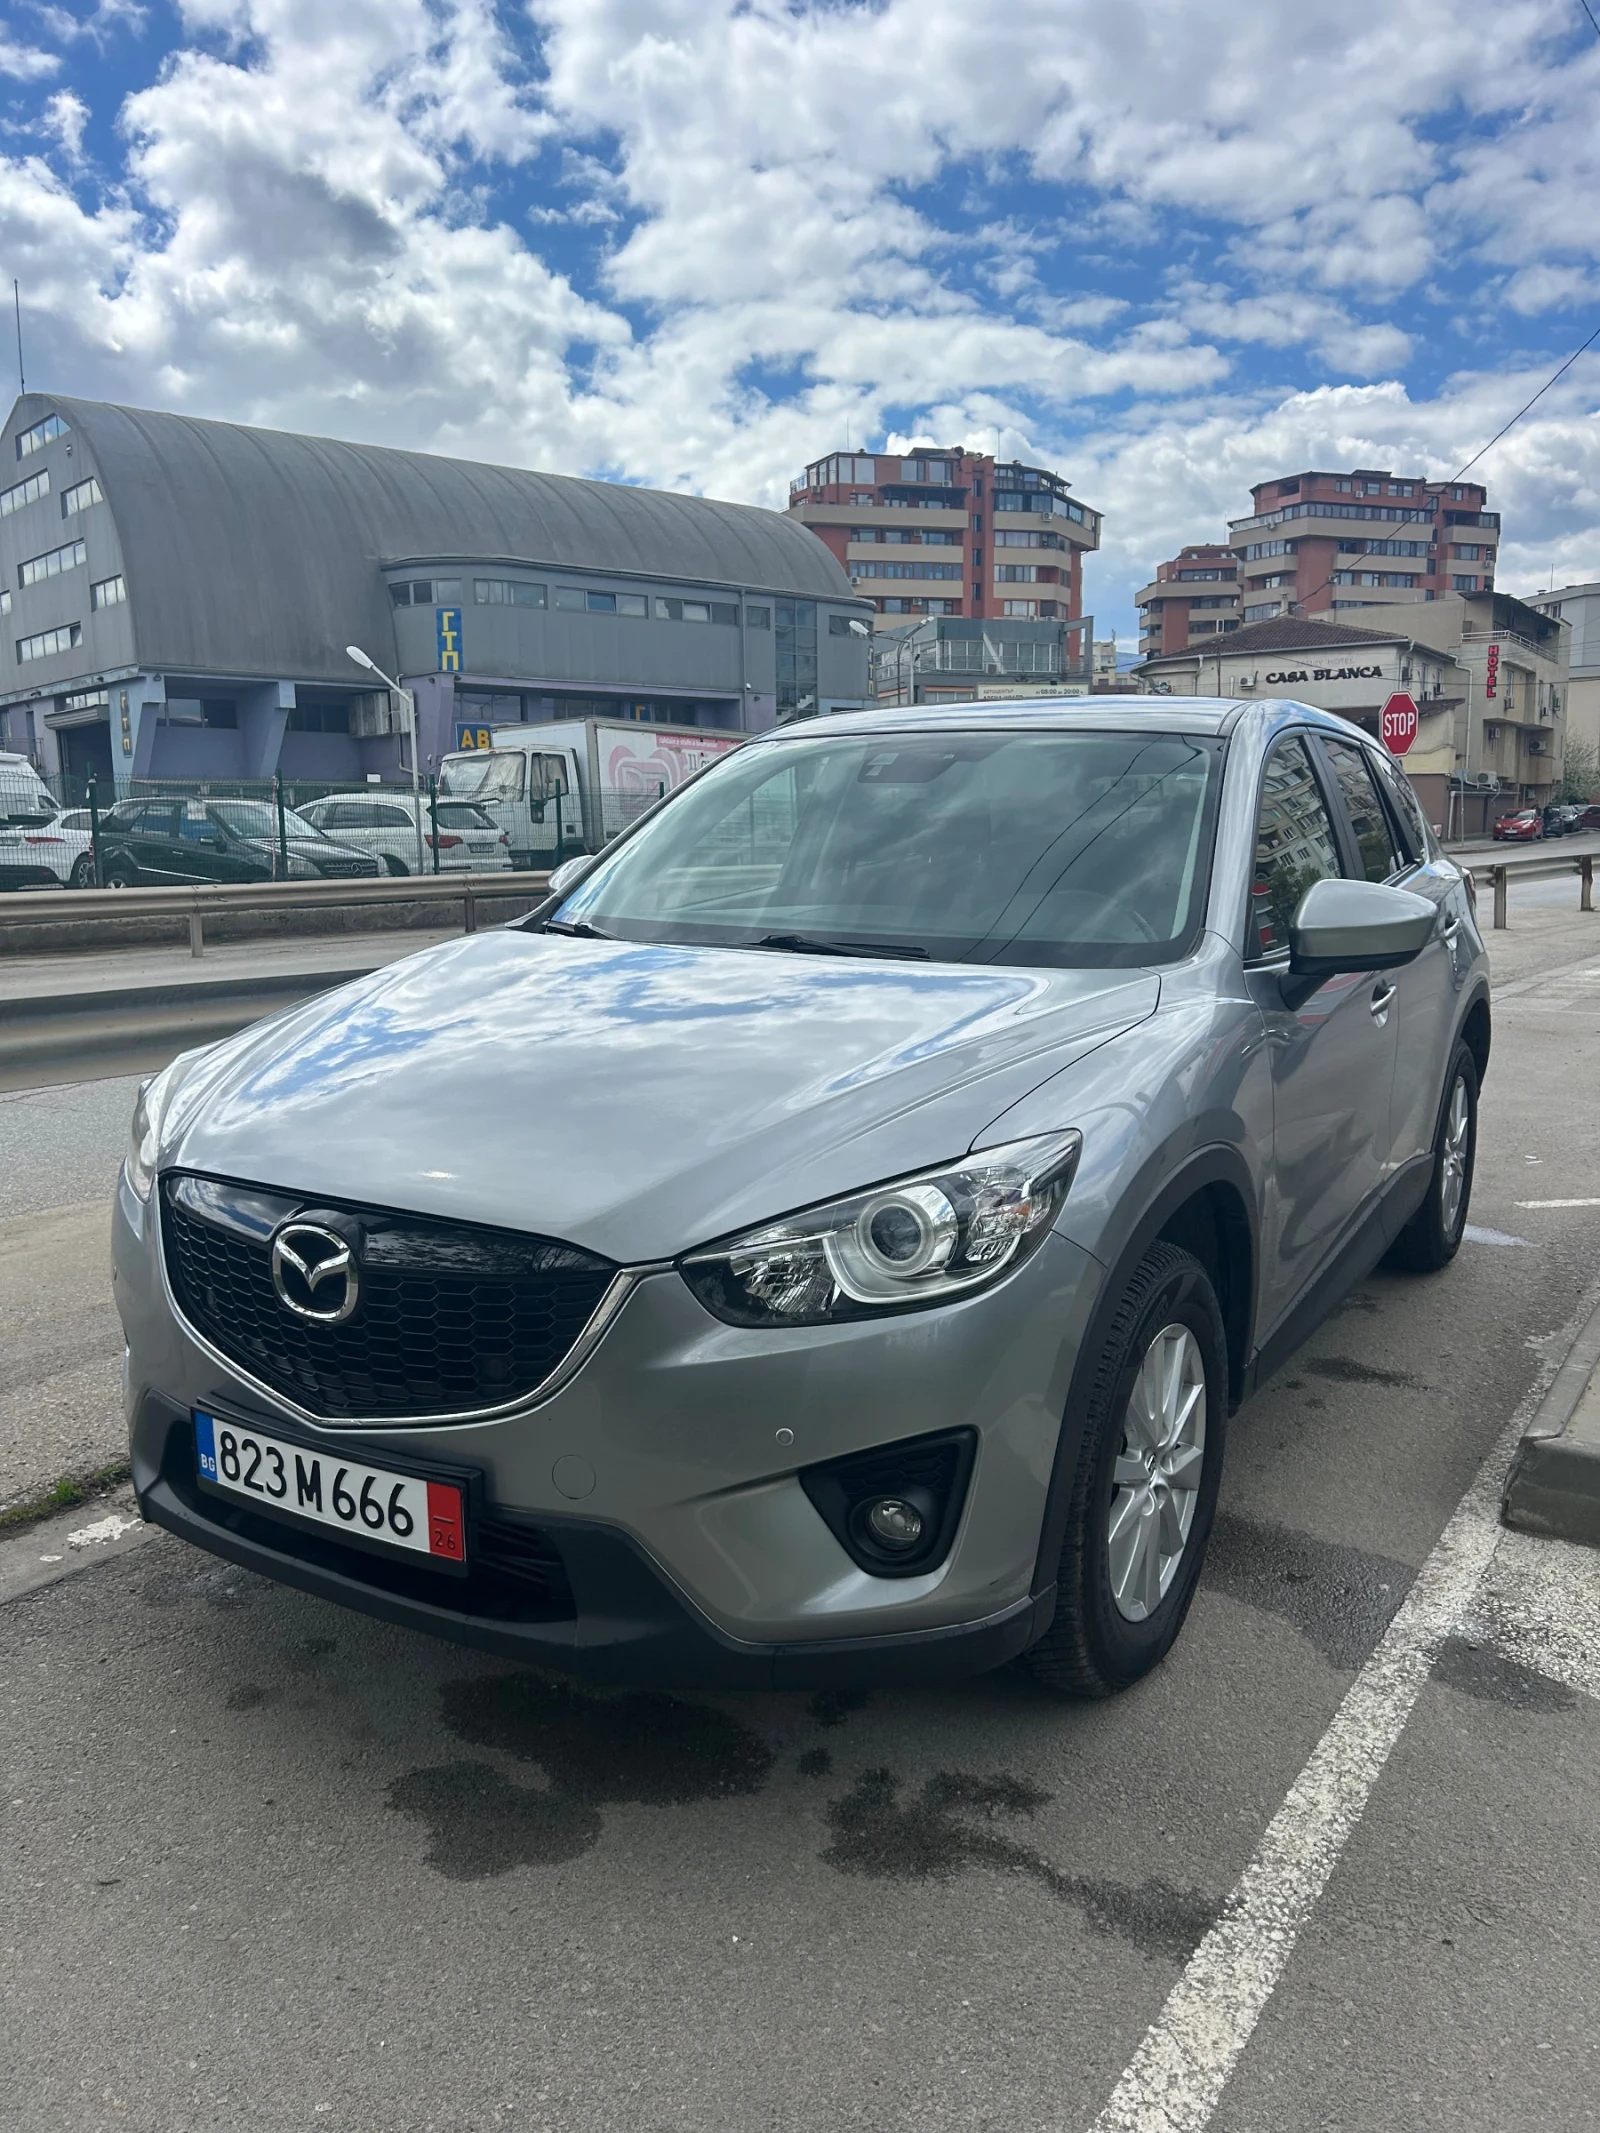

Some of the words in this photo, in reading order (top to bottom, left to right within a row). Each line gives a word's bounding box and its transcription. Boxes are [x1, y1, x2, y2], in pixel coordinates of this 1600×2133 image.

[441, 611, 459, 671] ГТП
[1266, 670, 1309, 684] CASA
[1313, 666, 1383, 682] BLANCA
[1487, 645, 1499, 698] HOTEL
[1383, 711, 1416, 738] STOP
[200, 1453, 216, 1472] BG
[435, 1530, 456, 1551] 26
